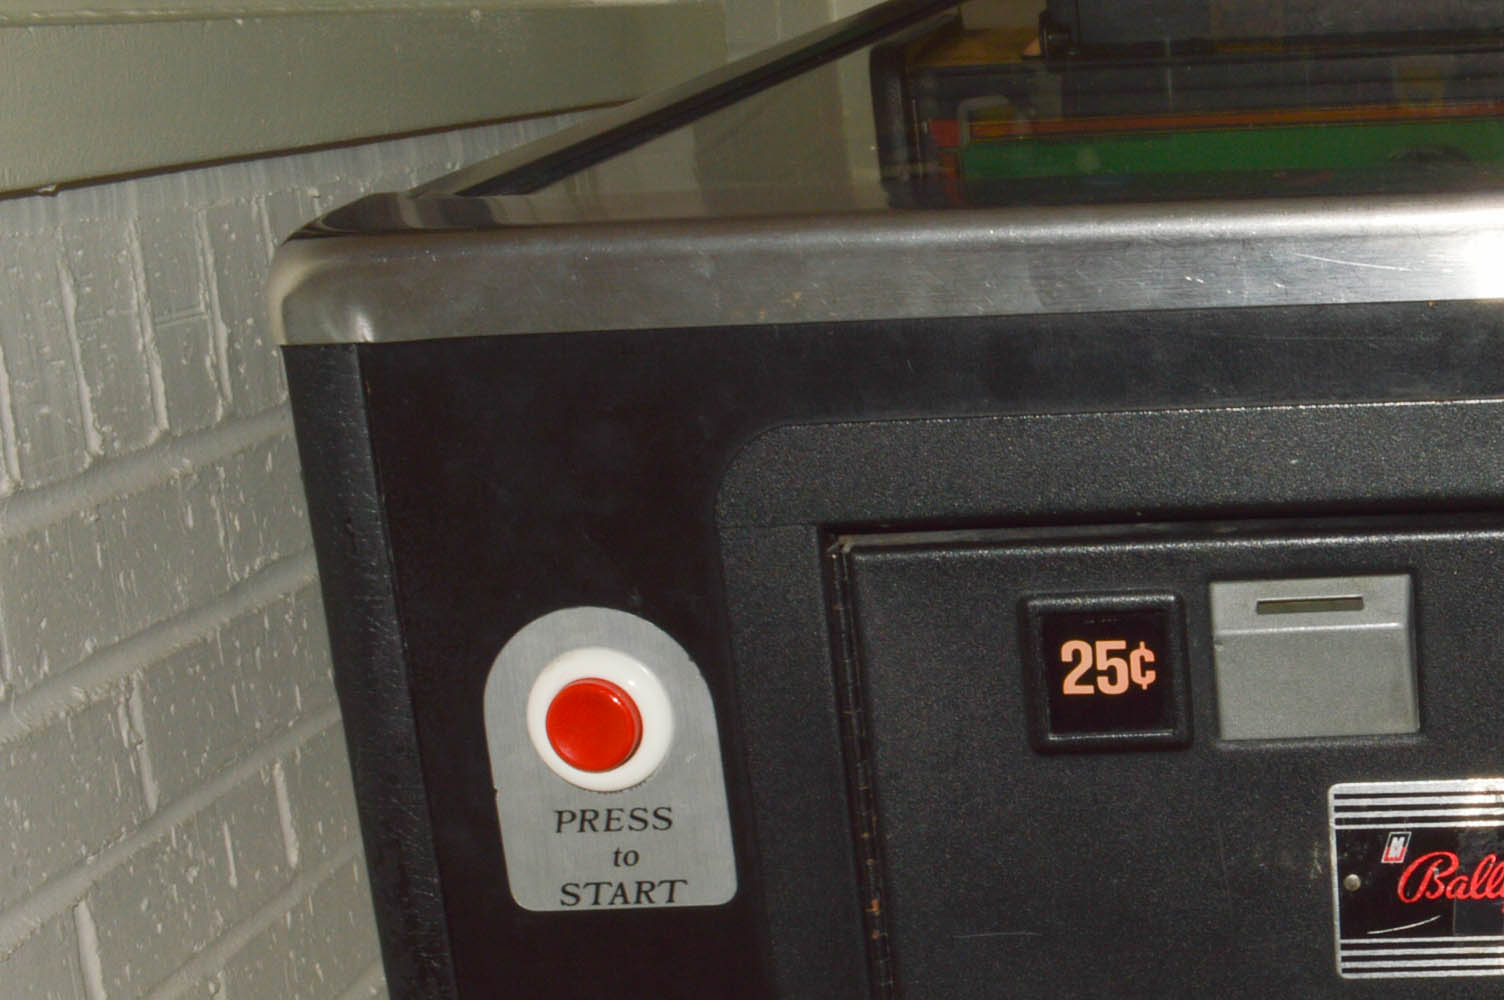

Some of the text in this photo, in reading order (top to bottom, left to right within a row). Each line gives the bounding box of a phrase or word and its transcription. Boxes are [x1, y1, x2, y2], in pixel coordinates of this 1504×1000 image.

[1060, 640, 1157, 695] 25¢
[554, 806, 673, 833] PRESS
[612, 847, 640, 867] to
[559, 879, 688, 906] START
